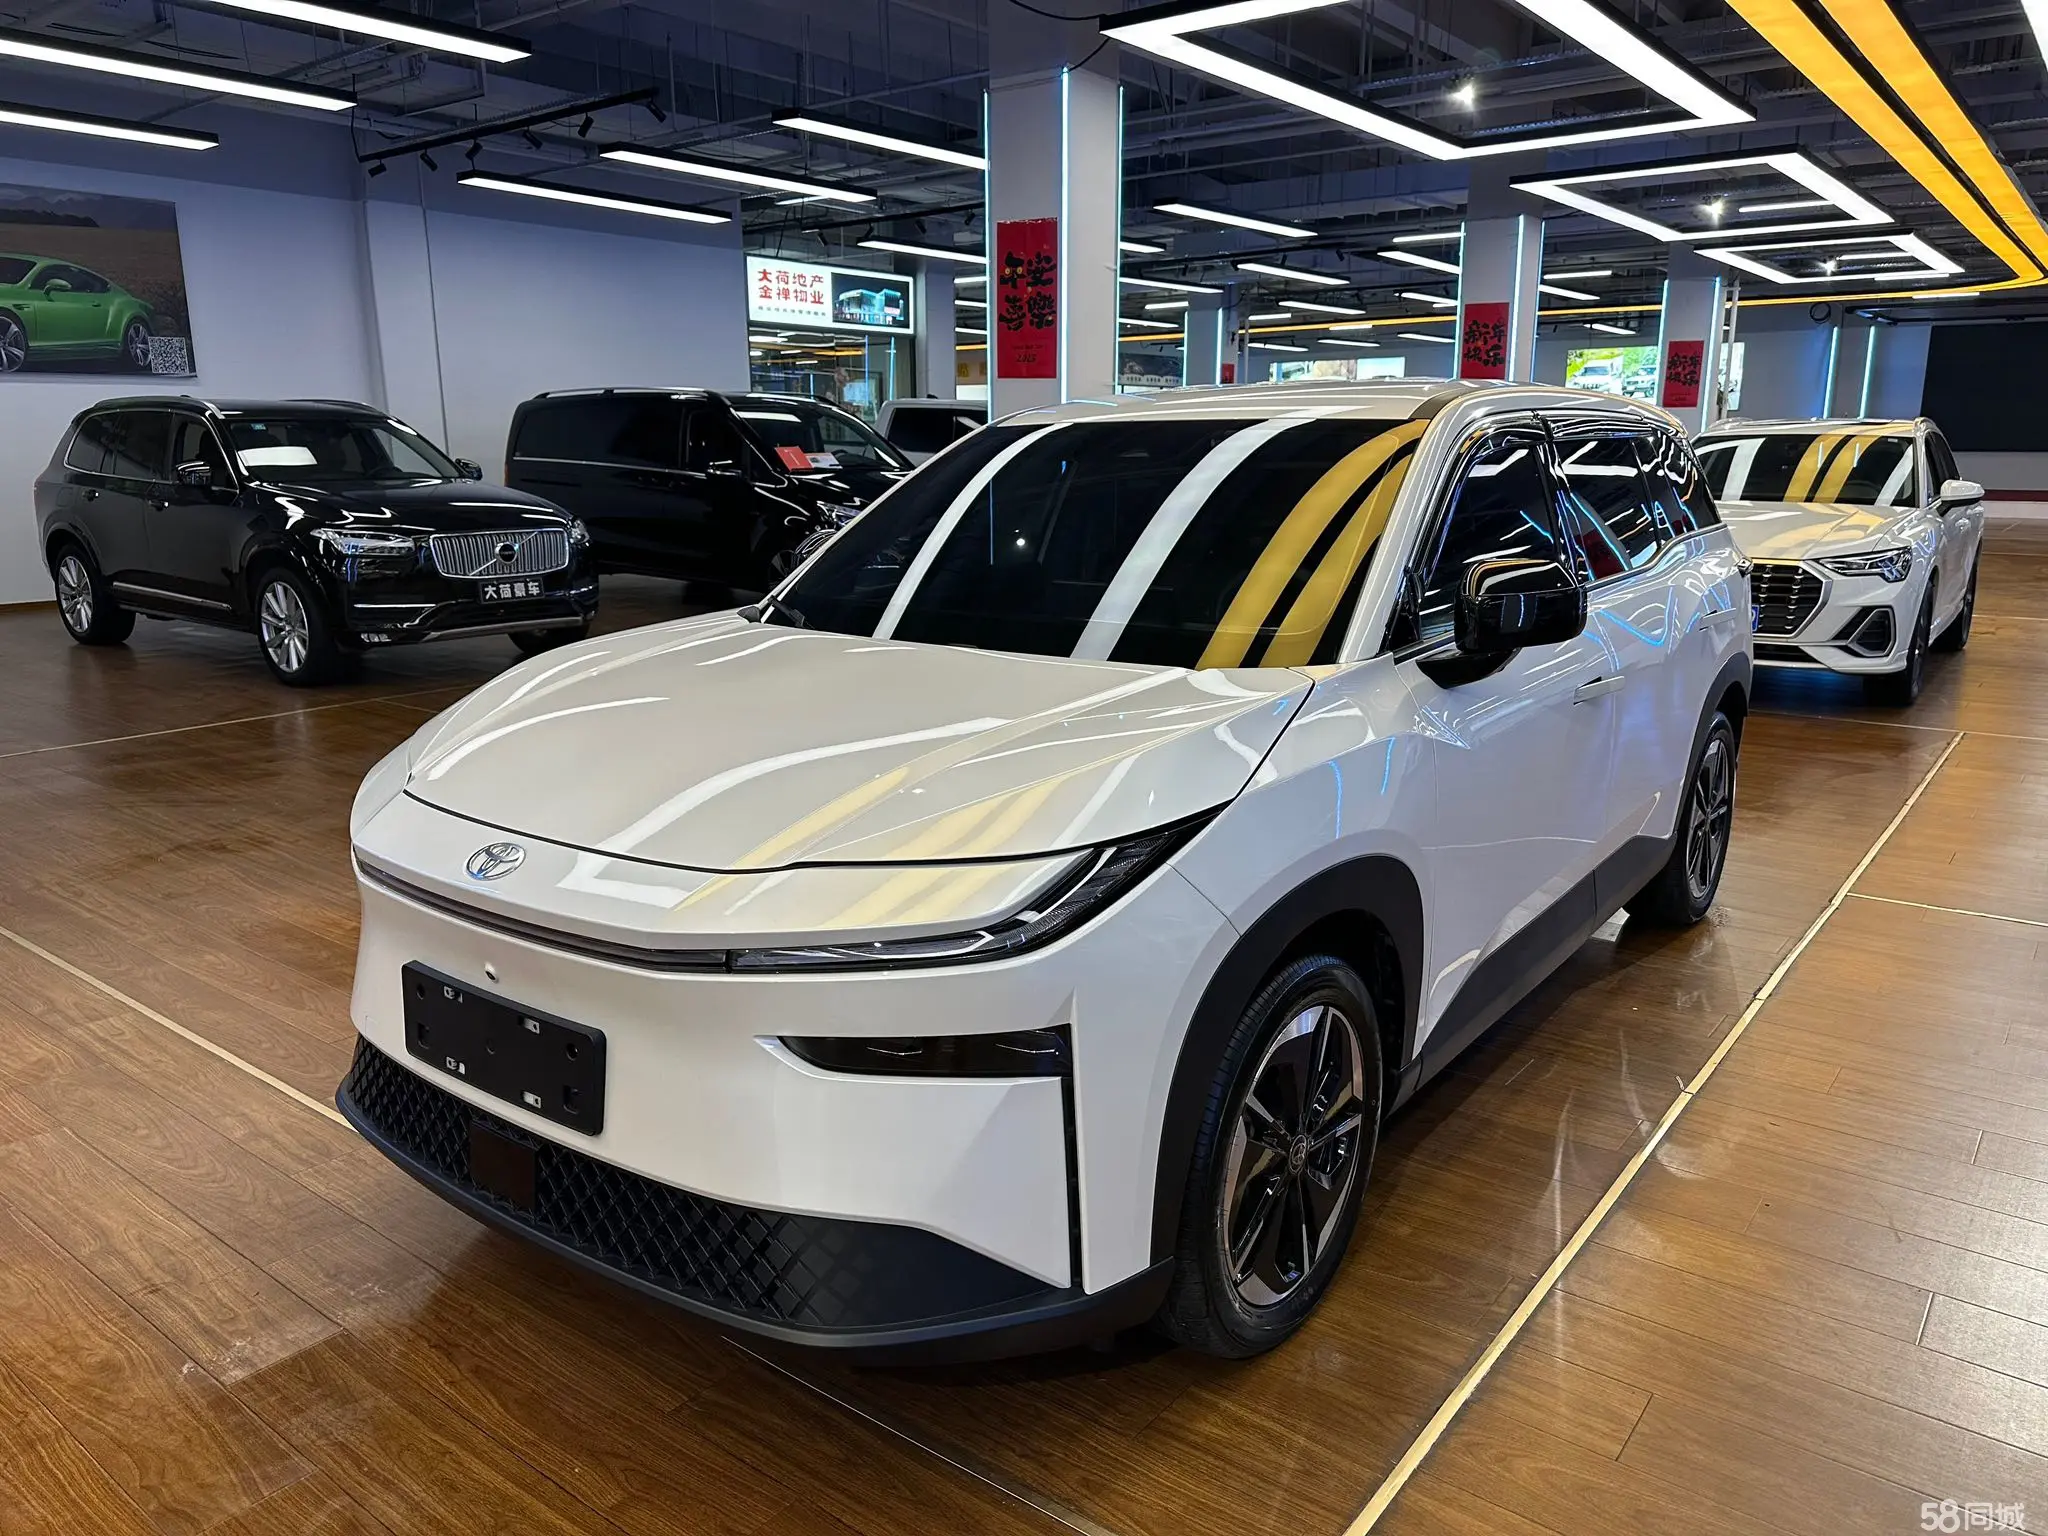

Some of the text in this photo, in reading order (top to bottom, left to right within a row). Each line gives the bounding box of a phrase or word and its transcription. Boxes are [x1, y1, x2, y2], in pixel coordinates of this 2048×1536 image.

[758, 269, 824, 288] 大荷地产
[758, 285, 824, 305] 金禅物业
[1464, 320, 1507, 345] 新年
[484, 582, 540, 600] 大荷豪车
